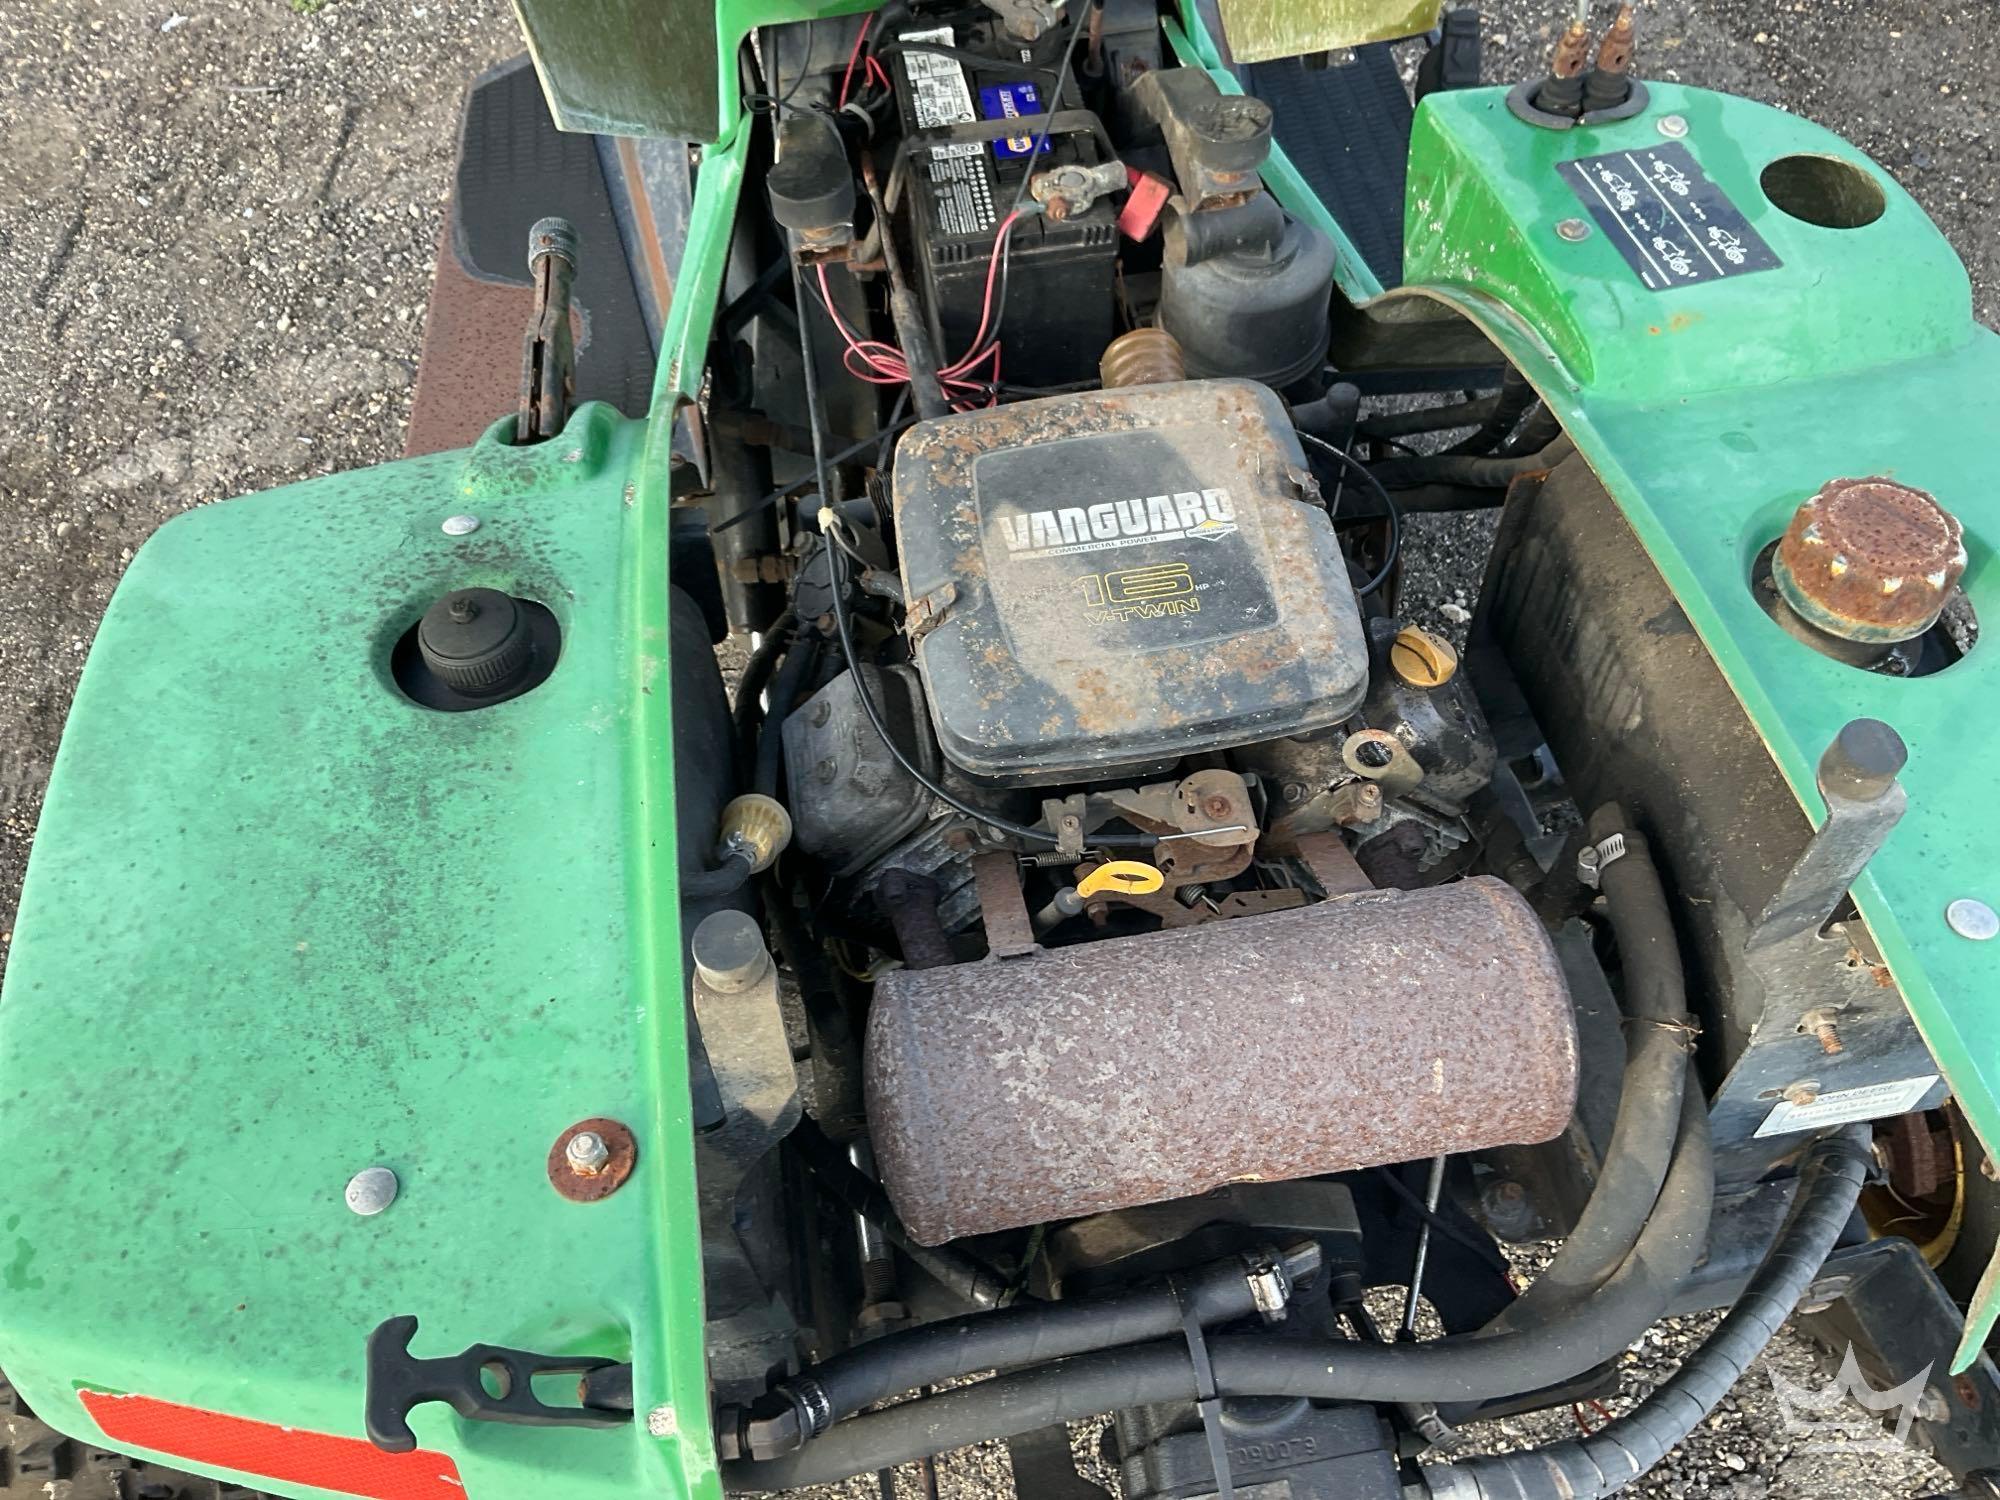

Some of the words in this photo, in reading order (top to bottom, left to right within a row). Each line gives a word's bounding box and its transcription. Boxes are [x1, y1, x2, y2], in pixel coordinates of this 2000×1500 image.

[995, 488, 1237, 550] VANGUARD
[1048, 539, 1117, 555] COMMERCIAL
[1119, 535, 1158, 547] POWER
[1071, 562, 1194, 607] 16
[1195, 583, 1209, 591] HP
[1083, 598, 1201, 626] V-TWIN
